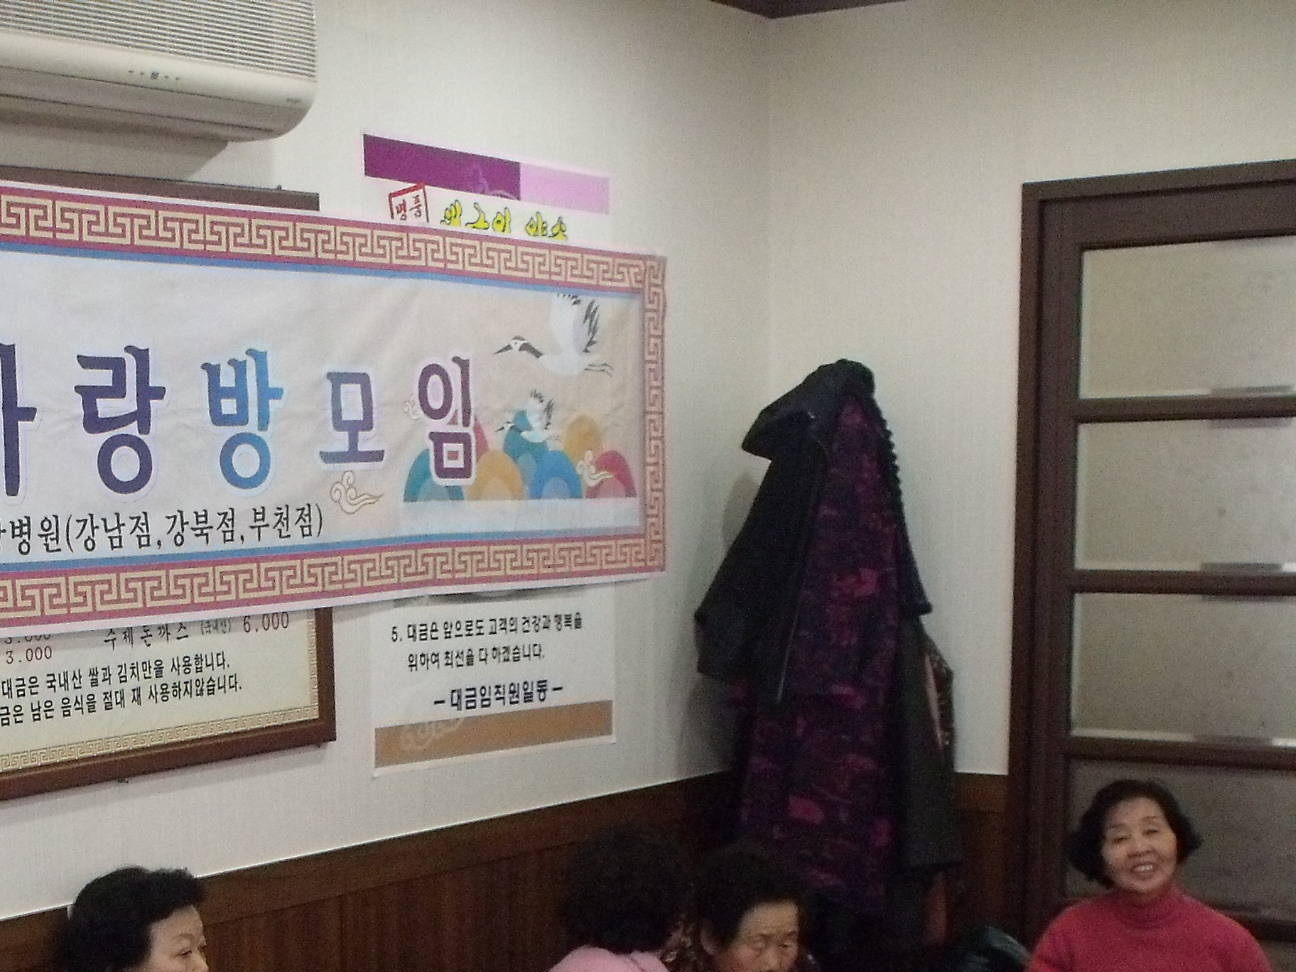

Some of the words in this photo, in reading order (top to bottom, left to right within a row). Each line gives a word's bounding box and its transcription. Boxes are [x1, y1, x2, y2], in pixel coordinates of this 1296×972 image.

[243, 611, 289, 633] 6.000
[391, 626, 403, 642] 5.
[407, 621, 439, 642] 대금은
[443, 619, 484, 640] 앞으로도
[489, 616, 518, 635] 고객의
[522, 614, 551, 633] 건강과
[554, 612, 583, 631] 행복을
[6, 646, 53, 665] 3.000
[408, 651, 440, 672] 위하여
[444, 648, 474, 668] 최선을
[1, 675, 40, 700] 대금은
[46, 669, 82, 693] 국내산
[88, 666, 112, 688] 쌀과
[117, 659, 165, 684] 김치만을
[170, 651, 230, 676] 사용합니다.
[30, 699, 54, 722] 남은
[61, 693, 97, 718] 음식을
[103, 687, 125, 711] 절대
[131, 686, 142, 706] 재
